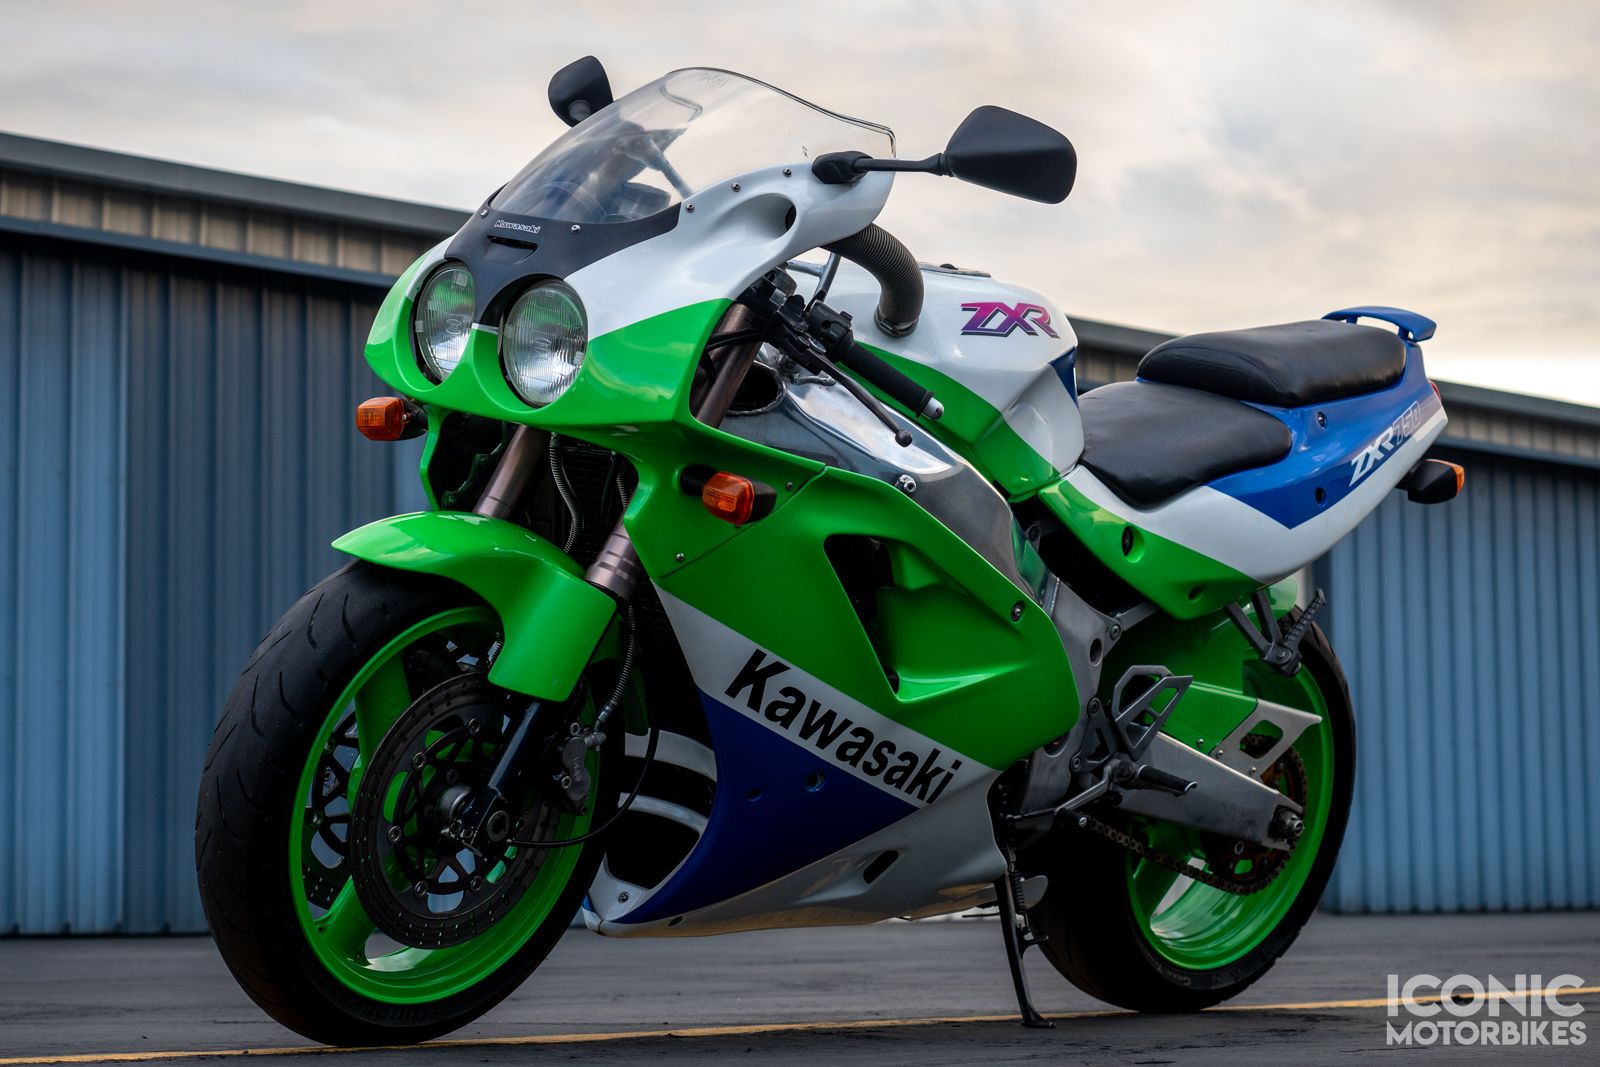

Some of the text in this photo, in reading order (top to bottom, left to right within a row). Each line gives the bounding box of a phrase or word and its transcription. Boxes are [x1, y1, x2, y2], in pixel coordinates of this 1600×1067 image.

[494, 219, 541, 233] Kawasaki
[960, 301, 1060, 339] ZXR
[724, 648, 962, 804] Kawasaki
